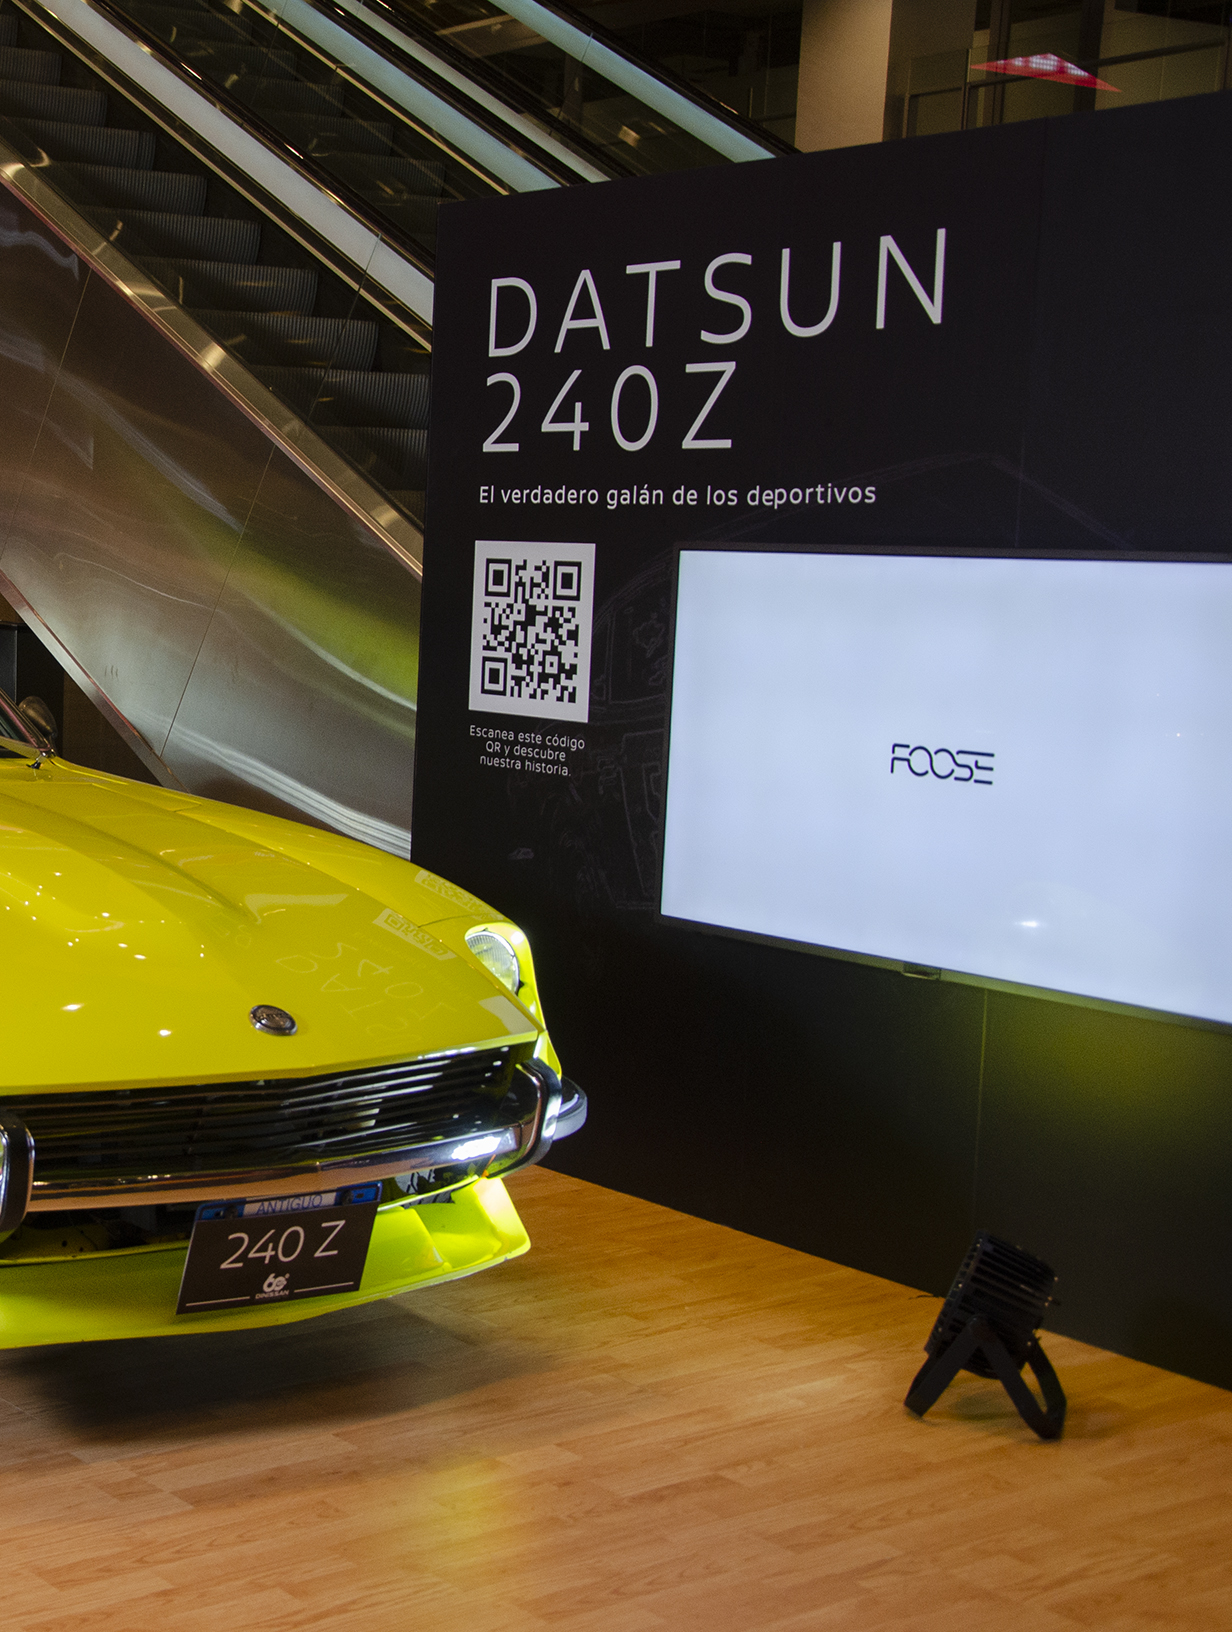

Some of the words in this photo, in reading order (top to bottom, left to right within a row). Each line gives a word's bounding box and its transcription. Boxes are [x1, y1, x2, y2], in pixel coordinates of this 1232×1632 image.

[488, 227, 946, 357] DATSUN
[482, 361, 736, 452] 240Z
[479, 485, 494, 503] El
[501, 484, 599, 504] verdadero
[606, 484, 664, 509] galán
[672, 485, 697, 505] de
[706, 484, 738, 506] los
[746, 482, 877, 509] deportivos
[469, 724, 514, 740] Escanea
[517, 732, 542, 744] este
[545, 733, 585, 751] código
[485, 741, 501, 753] QR
[504, 745, 510, 756] y
[513, 744, 566, 761] descubre
[479, 755, 521, 770] nuestra
[524, 759, 571, 776] historia.
[890, 743, 994, 785] FOOSE
[256, 1195, 323, 1215] ANTIGUO
[220, 1226, 305, 1270] 240
[314, 1220, 346, 1258] Z
